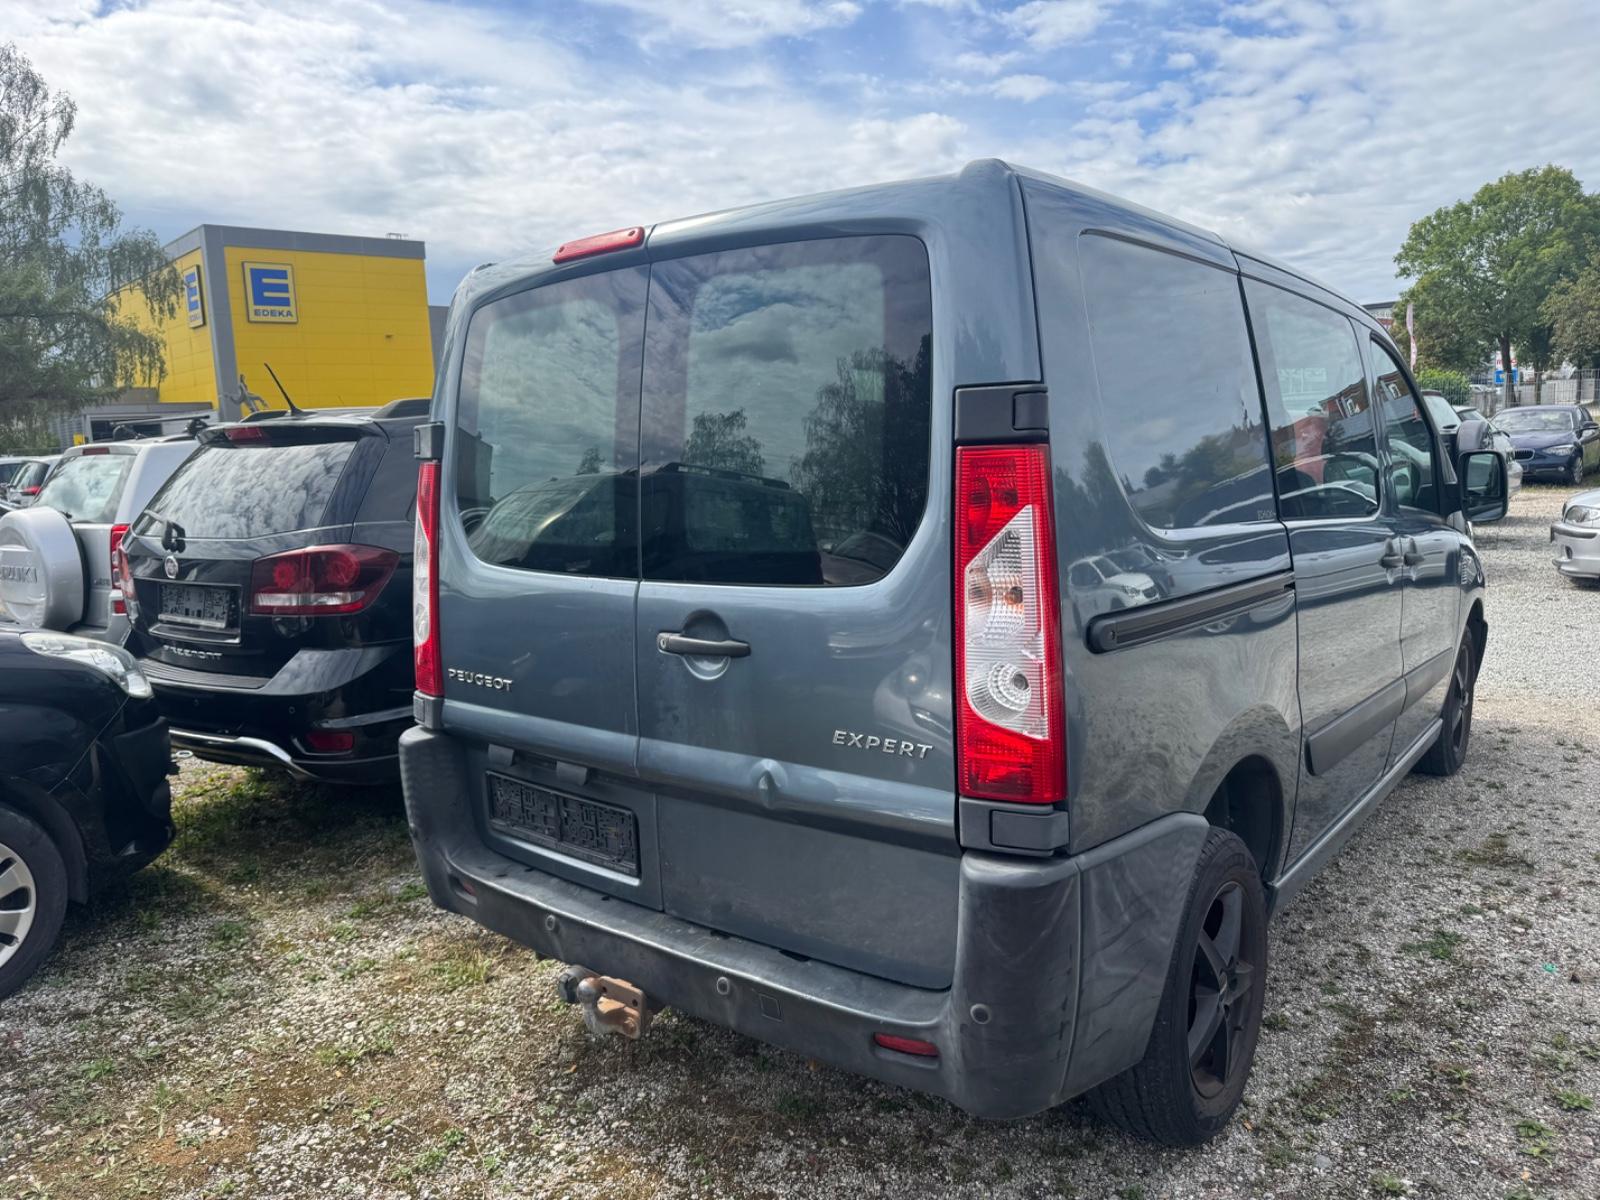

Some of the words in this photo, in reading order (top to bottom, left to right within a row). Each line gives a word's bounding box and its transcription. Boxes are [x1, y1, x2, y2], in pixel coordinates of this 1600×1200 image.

[250, 268, 291, 307] E
[254, 309, 293, 318] EDEKA
[448, 668, 513, 691] PEUGEOT
[832, 729, 933, 759] EXPERT
